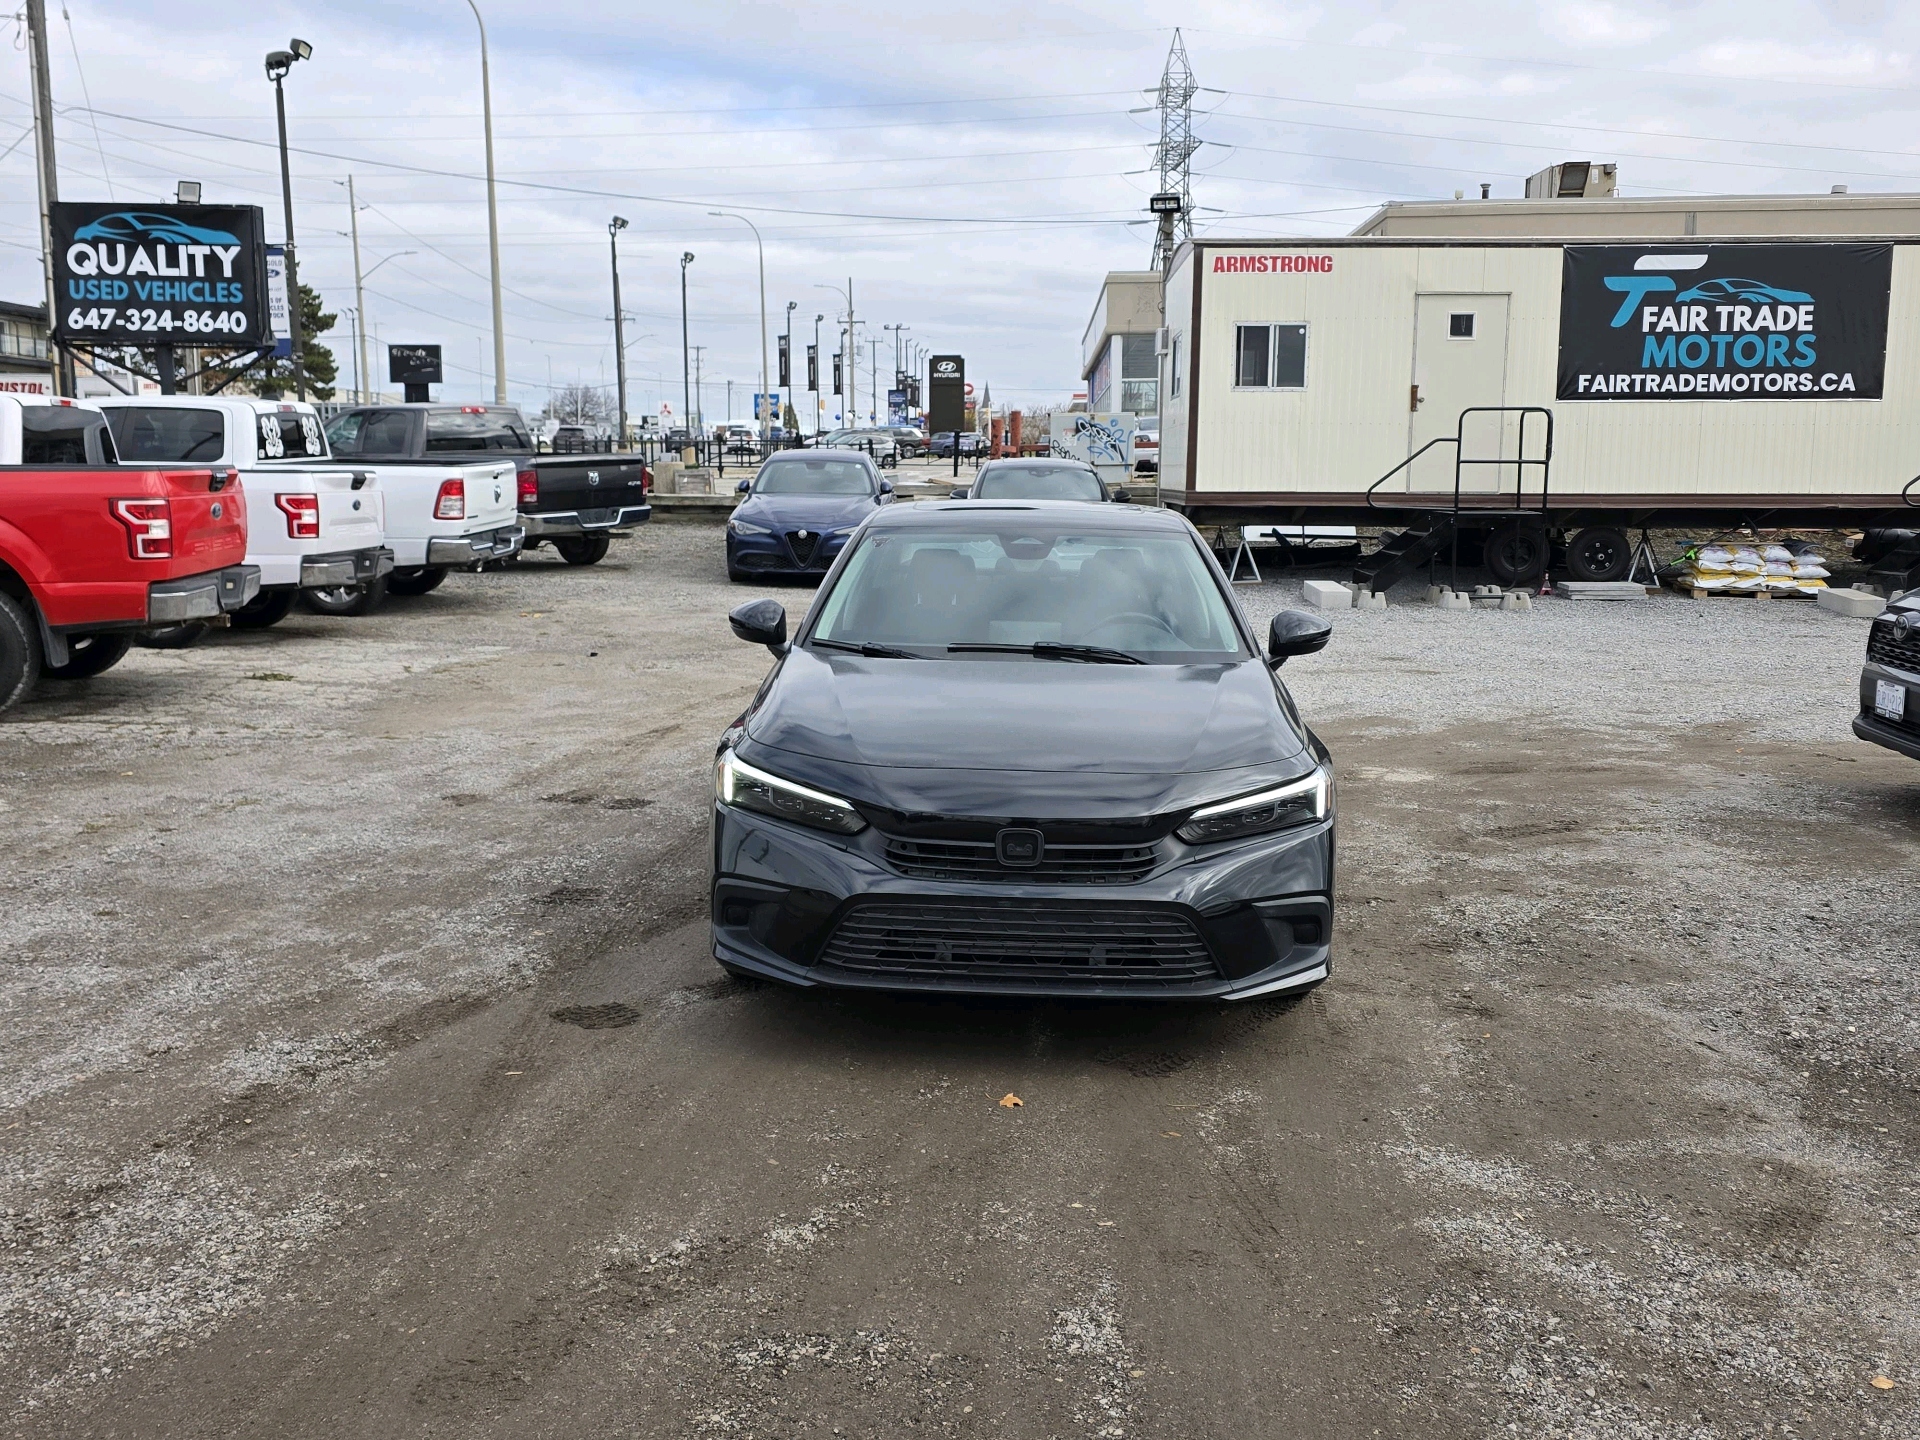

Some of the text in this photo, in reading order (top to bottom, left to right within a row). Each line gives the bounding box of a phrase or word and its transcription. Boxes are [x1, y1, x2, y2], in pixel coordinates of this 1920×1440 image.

[66, 242, 241, 278] QUALITY
[1213, 255, 1333, 273] ARMSTRONG
[68, 279, 244, 303] USED VEHICLES
[67, 307, 247, 333] 647-324-8640
[1642, 304, 1815, 333] FAIR TRADE
[1641, 333, 1817, 368] MOTORS
[1578, 372, 1856, 393] FAIRTRADEMOTORS.CA
